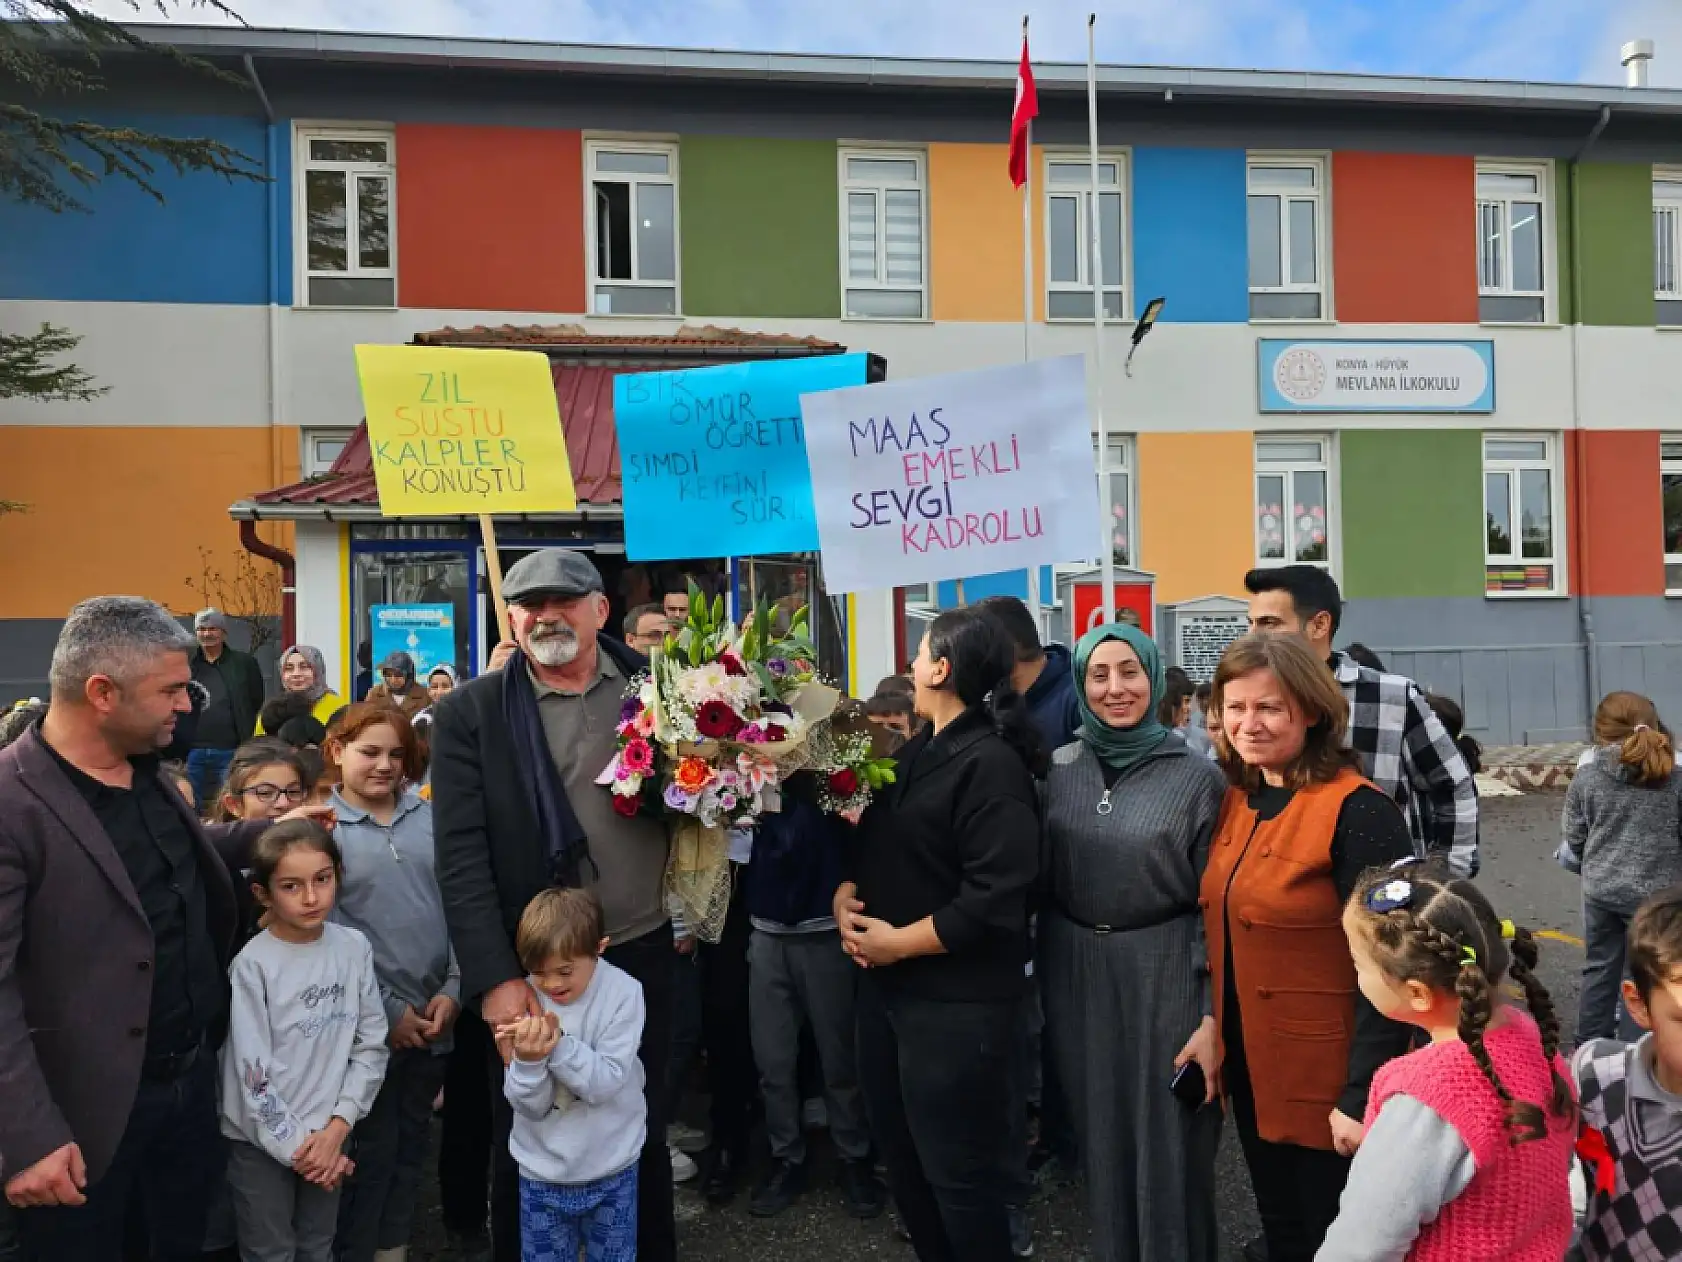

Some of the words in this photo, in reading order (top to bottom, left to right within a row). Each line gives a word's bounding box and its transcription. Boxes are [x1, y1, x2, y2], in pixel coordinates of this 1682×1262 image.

[1336, 358, 1368, 370] KONYA
[1377, 357, 1409, 371] HÜYÜK
[416, 371, 473, 404] ZİL
[1336, 376, 1397, 391] MEVLANA
[1399, 373, 1460, 391] İLKOKULU
[395, 406, 505, 437] SUSTU
[669, 390, 757, 425] ÖMÜR
[848, 407, 951, 458] MAAŞ
[375, 439, 525, 466] KALPLER
[630, 448, 699, 484] ŞİMDİ
[902, 433, 1021, 487] EMEKLİ
[402, 463, 527, 498] KONUŞTU
[679, 468, 767, 502] KEYFİNİ
[849, 481, 953, 529] SEVGİ
[901, 505, 1044, 555] KADROLU
